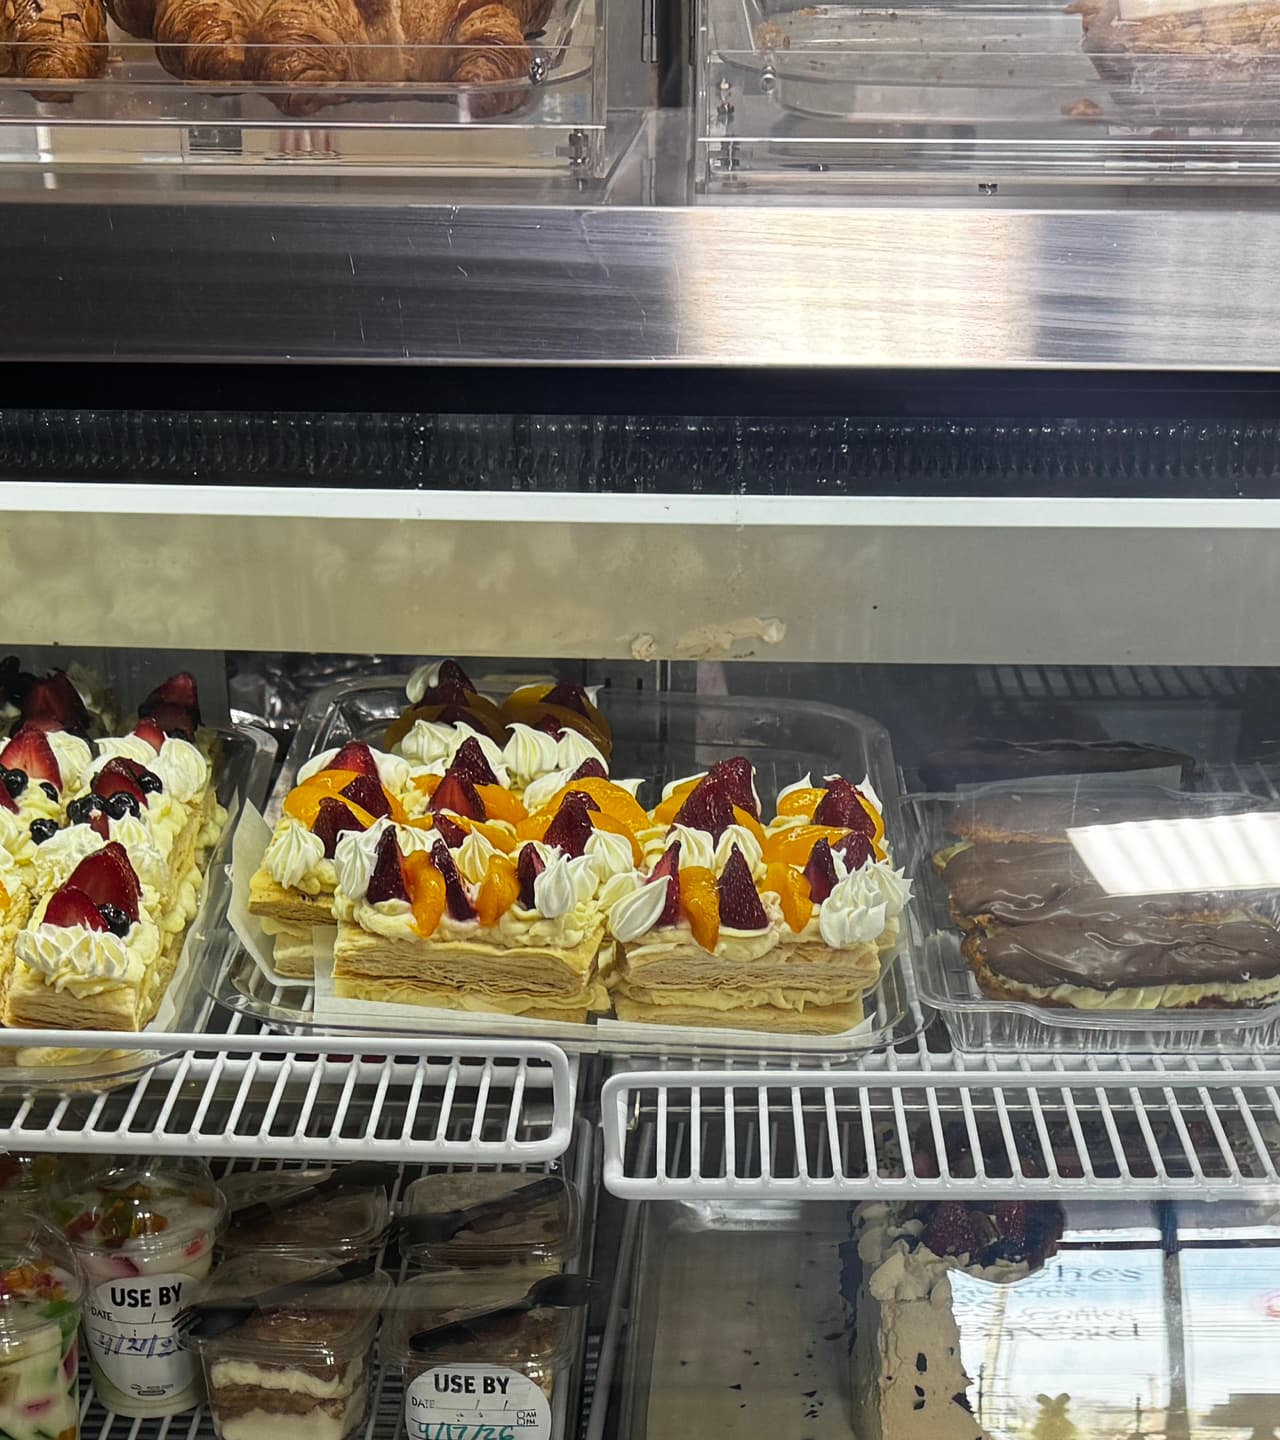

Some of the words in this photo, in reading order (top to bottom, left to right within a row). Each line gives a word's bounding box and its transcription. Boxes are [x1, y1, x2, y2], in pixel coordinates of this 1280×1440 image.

[110, 1287, 152, 1308] USE
[158, 1282, 182, 1306] BY
[90, 1306, 113, 1321] DATE
[433, 1373, 476, 1394] USE
[483, 1375, 510, 1395] BY
[411, 1396, 436, 1409] DATE
